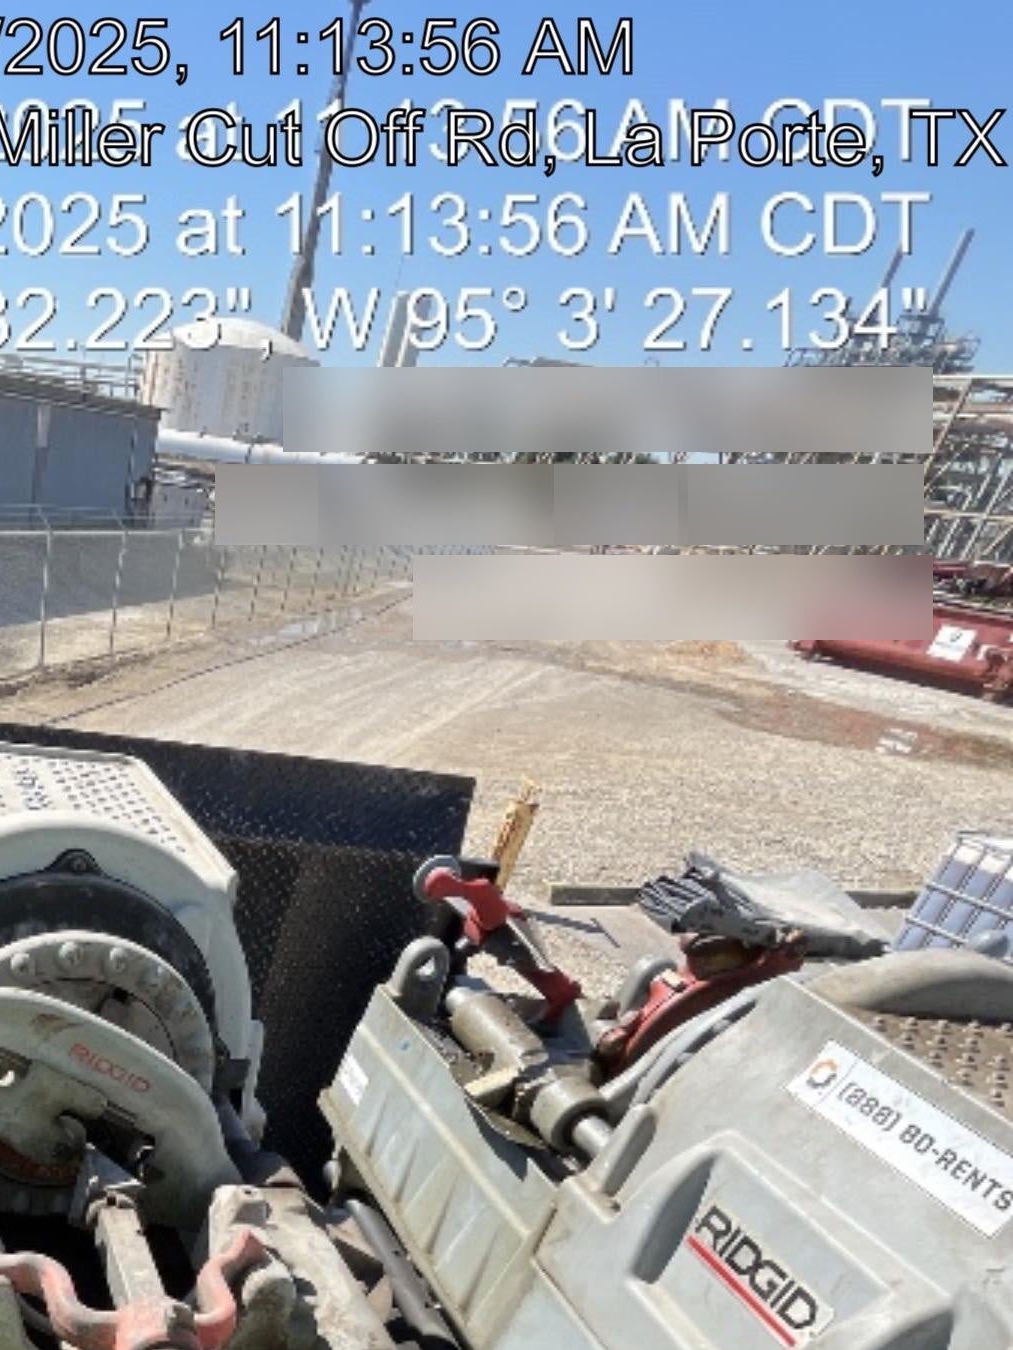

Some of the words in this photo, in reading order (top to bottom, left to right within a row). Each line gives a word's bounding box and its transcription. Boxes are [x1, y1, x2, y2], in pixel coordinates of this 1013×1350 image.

[837, 1081, 901, 1131] (888)
[898, 1124, 1013, 1212] 80-RENTS
[695, 1205, 817, 1329] RIDGID
